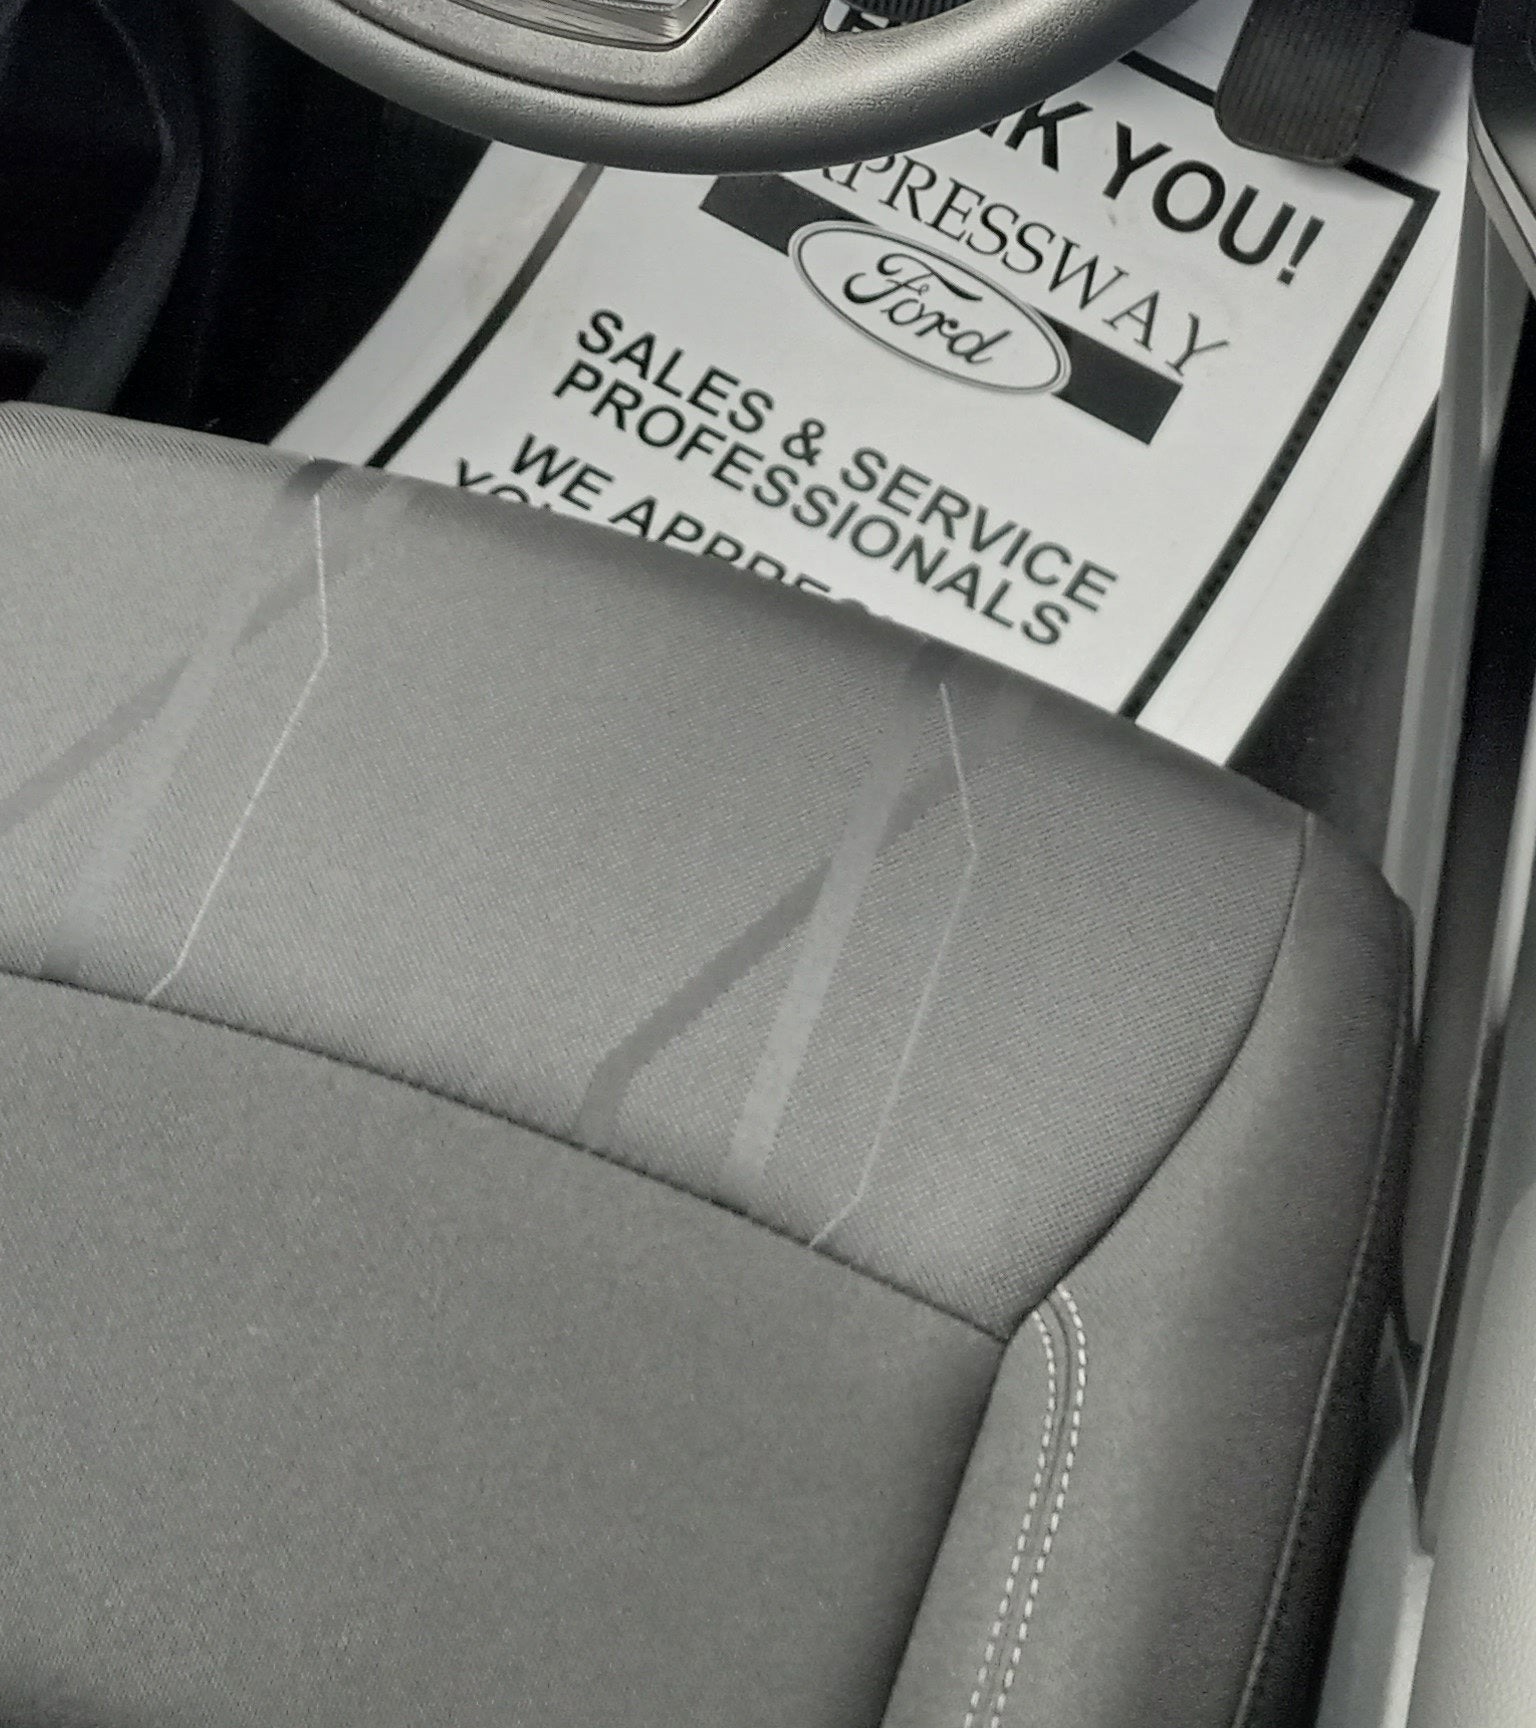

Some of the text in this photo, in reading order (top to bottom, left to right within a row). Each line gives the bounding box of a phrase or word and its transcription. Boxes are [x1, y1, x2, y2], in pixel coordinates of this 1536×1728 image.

[821, 154, 1230, 376] PRESSWAY
[1102, 120, 1326, 287] YOU!
[842, 252, 1013, 366] Ford
[510, 432, 616, 512] WE
[553, 358, 1073, 647] PROFESSIONALS
[576, 306, 1119, 614] SALES & SERVICE
